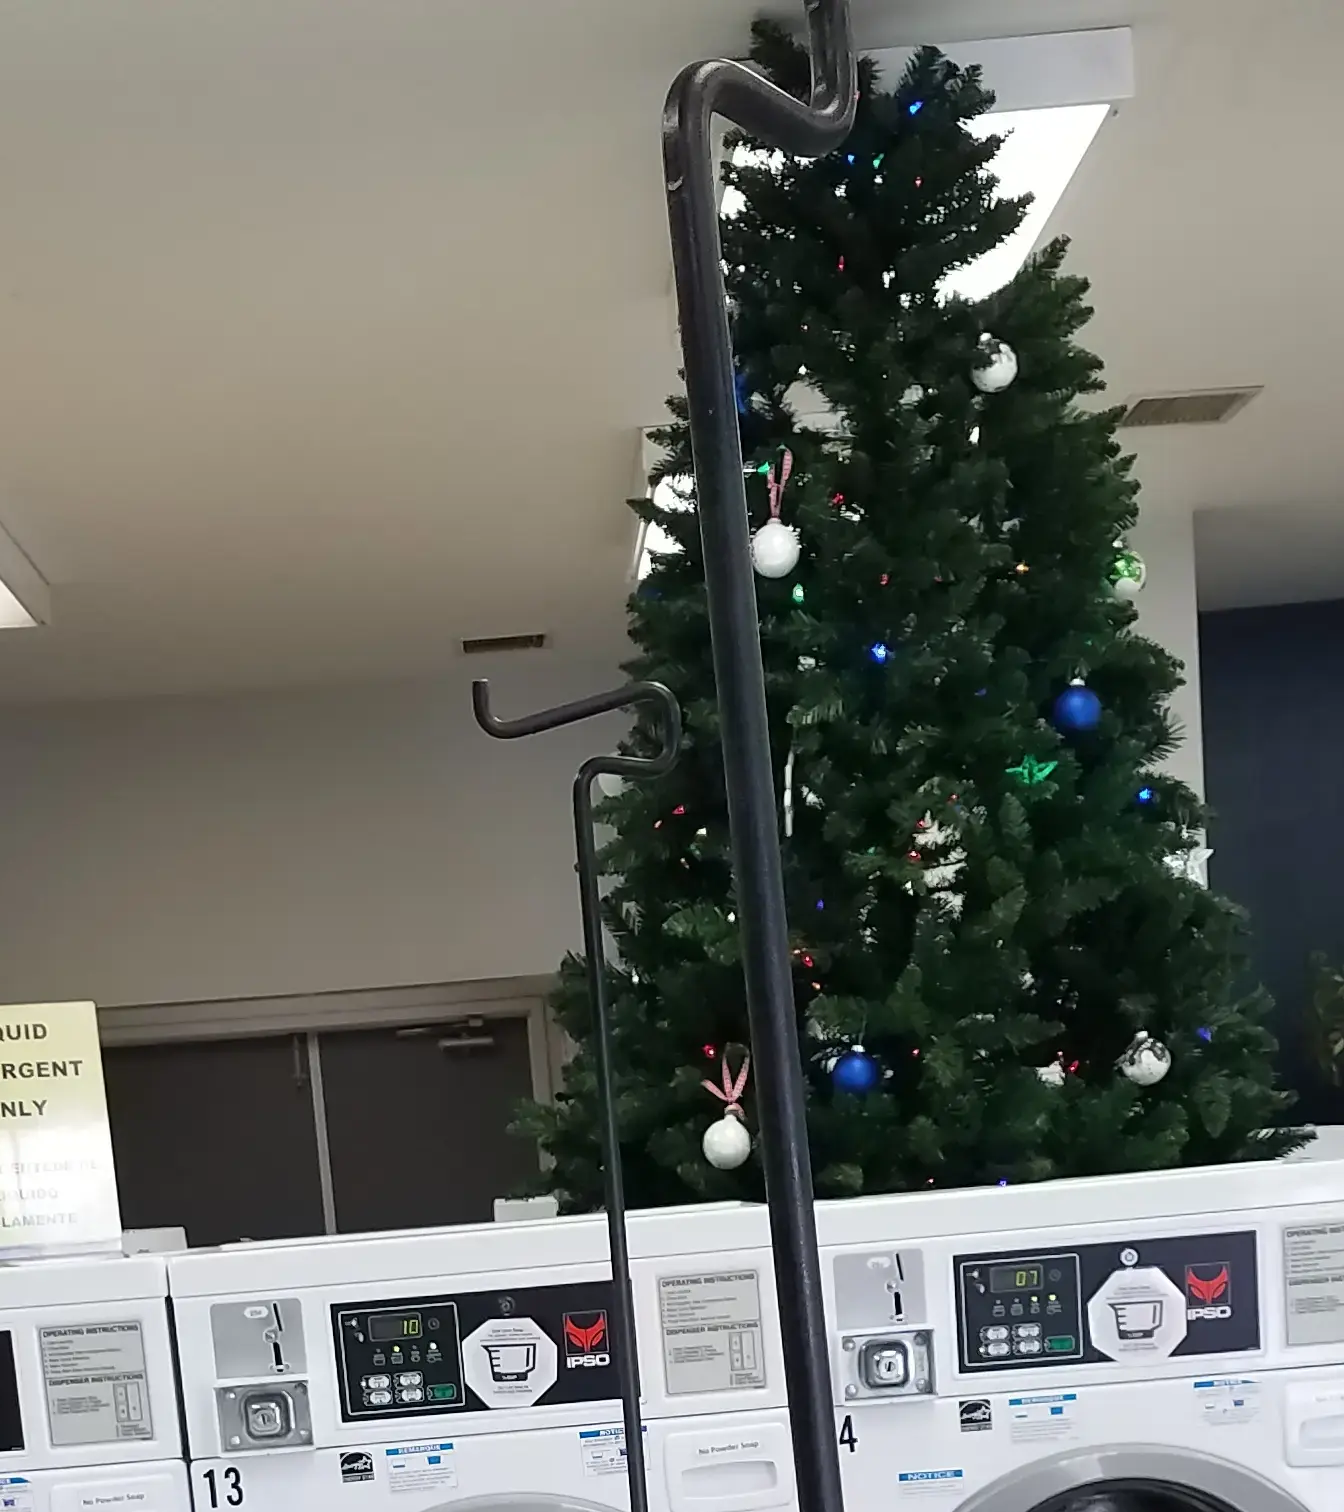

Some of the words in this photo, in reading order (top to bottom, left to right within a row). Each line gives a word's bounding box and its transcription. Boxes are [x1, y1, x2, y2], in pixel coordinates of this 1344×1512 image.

[1016, 1270, 1038, 1287] 07
[1187, 1306, 1231, 1321] IPSO
[403, 1319, 419, 1335] 10
[566, 1354, 610, 1369] IPSO
[838, 1414, 859, 1453] 4
[906, 1470, 955, 1481] NOTICE
[201, 1467, 244, 1509] 13
